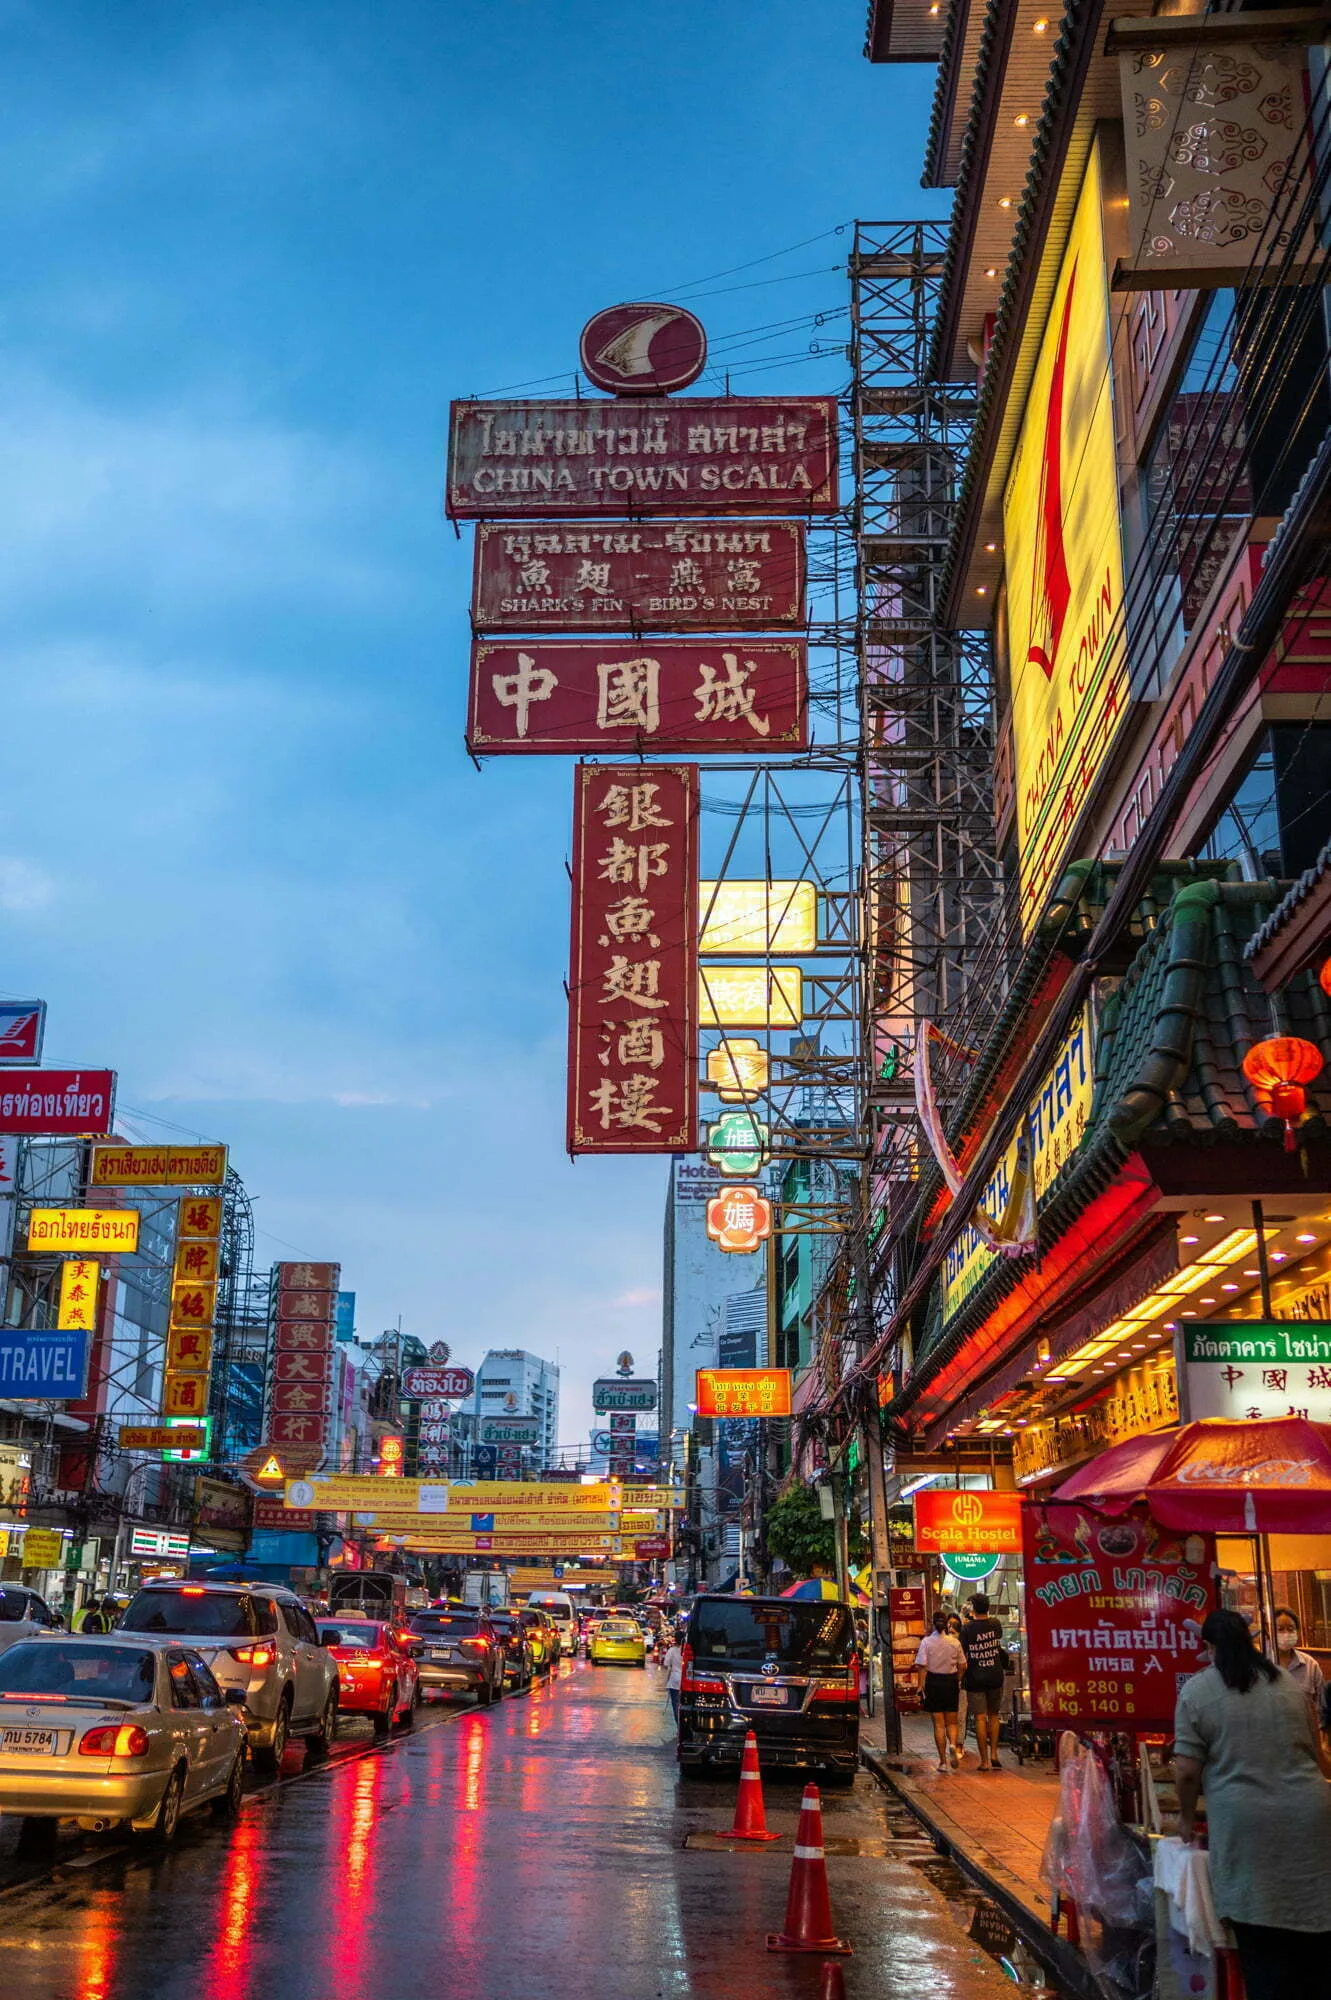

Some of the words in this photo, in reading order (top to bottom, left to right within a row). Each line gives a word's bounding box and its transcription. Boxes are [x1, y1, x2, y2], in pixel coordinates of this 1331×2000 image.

[473, 468, 577, 493] CHINA
[587, 465, 690, 491] TOWN
[701, 464, 813, 491] SCALA
[500, 598, 585, 612] SHARK'S
[591, 598, 624, 612] FIN
[649, 597, 715, 611] BIRD'S
[721, 596, 773, 611] NEST
[492, 652, 770, 737] 中國城
[1024, 707, 1064, 837] CHINA
[1069, 565, 1113, 714] TOWN
[588, 782, 675, 1134] 銀都魚翅酒樓
[0, 1073, 104, 1118] รท่องเที่ยว
[31, 1212, 136, 1240] เอกไทยรังนก
[723, 1202, 754, 1234] 媽
[1193, 1334, 1276, 1358] ภัตตาคาร
[1277, 1331, 1331, 1358] ไชน่า
[1, 1346, 77, 1382] TRAVEL
[1220, 1364, 1331, 1395] 中國城
[921, 1527, 964, 1541] Scala
[967, 1526, 1016, 1541] Hostel
[954, 1555, 987, 1564] JUMAMA
[1035, 1568, 1102, 1608] หยก
[976, 1631, 995, 1642] ANTI
[1050, 1611, 1199, 1659] เกาลัดญี่ปุ่น
[1143, 1654, 1164, 1675] A
[1056, 1679, 1081, 1695] kg.
[1087, 1680, 1119, 1694] 280
[1059, 1698, 1083, 1716] kg.
[1090, 1699, 1120, 1713] 140
[25, 1732, 52, 1746] 5784
